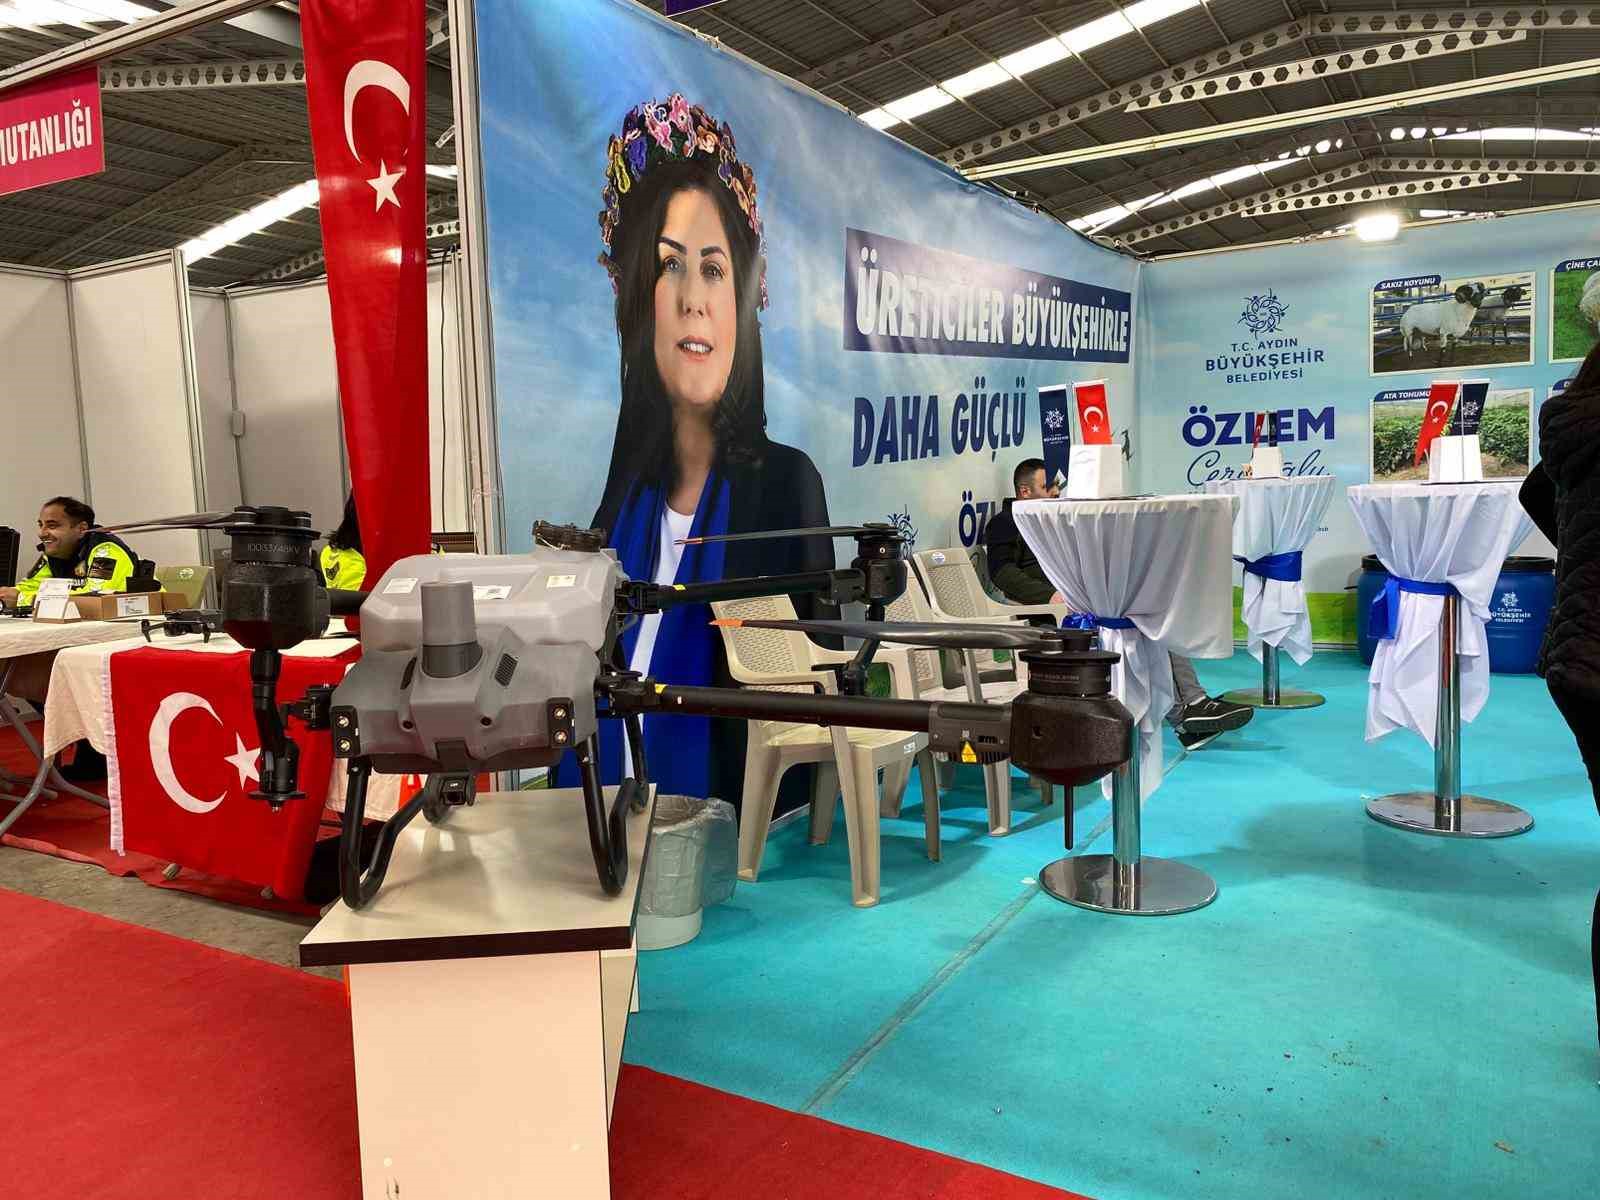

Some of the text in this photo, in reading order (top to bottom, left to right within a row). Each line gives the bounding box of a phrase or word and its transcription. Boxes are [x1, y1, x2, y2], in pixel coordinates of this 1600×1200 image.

[1381, 277, 1436, 290] SAKIZ KOYUNU
[1012, 282, 1128, 358] BÜYÜKŞEHİRLE
[1231, 338, 1298, 352] T.C. AYDIN
[1206, 348, 1325, 371] BÜYÜKŞEHİR
[1226, 368, 1303, 383] BELEDİYESİ
[1383, 390, 1431, 400] ATA TOHUMU
[852, 376, 1027, 467] DAHA GÜÇLÜ
[1182, 405, 1335, 447] ÖZLEM
